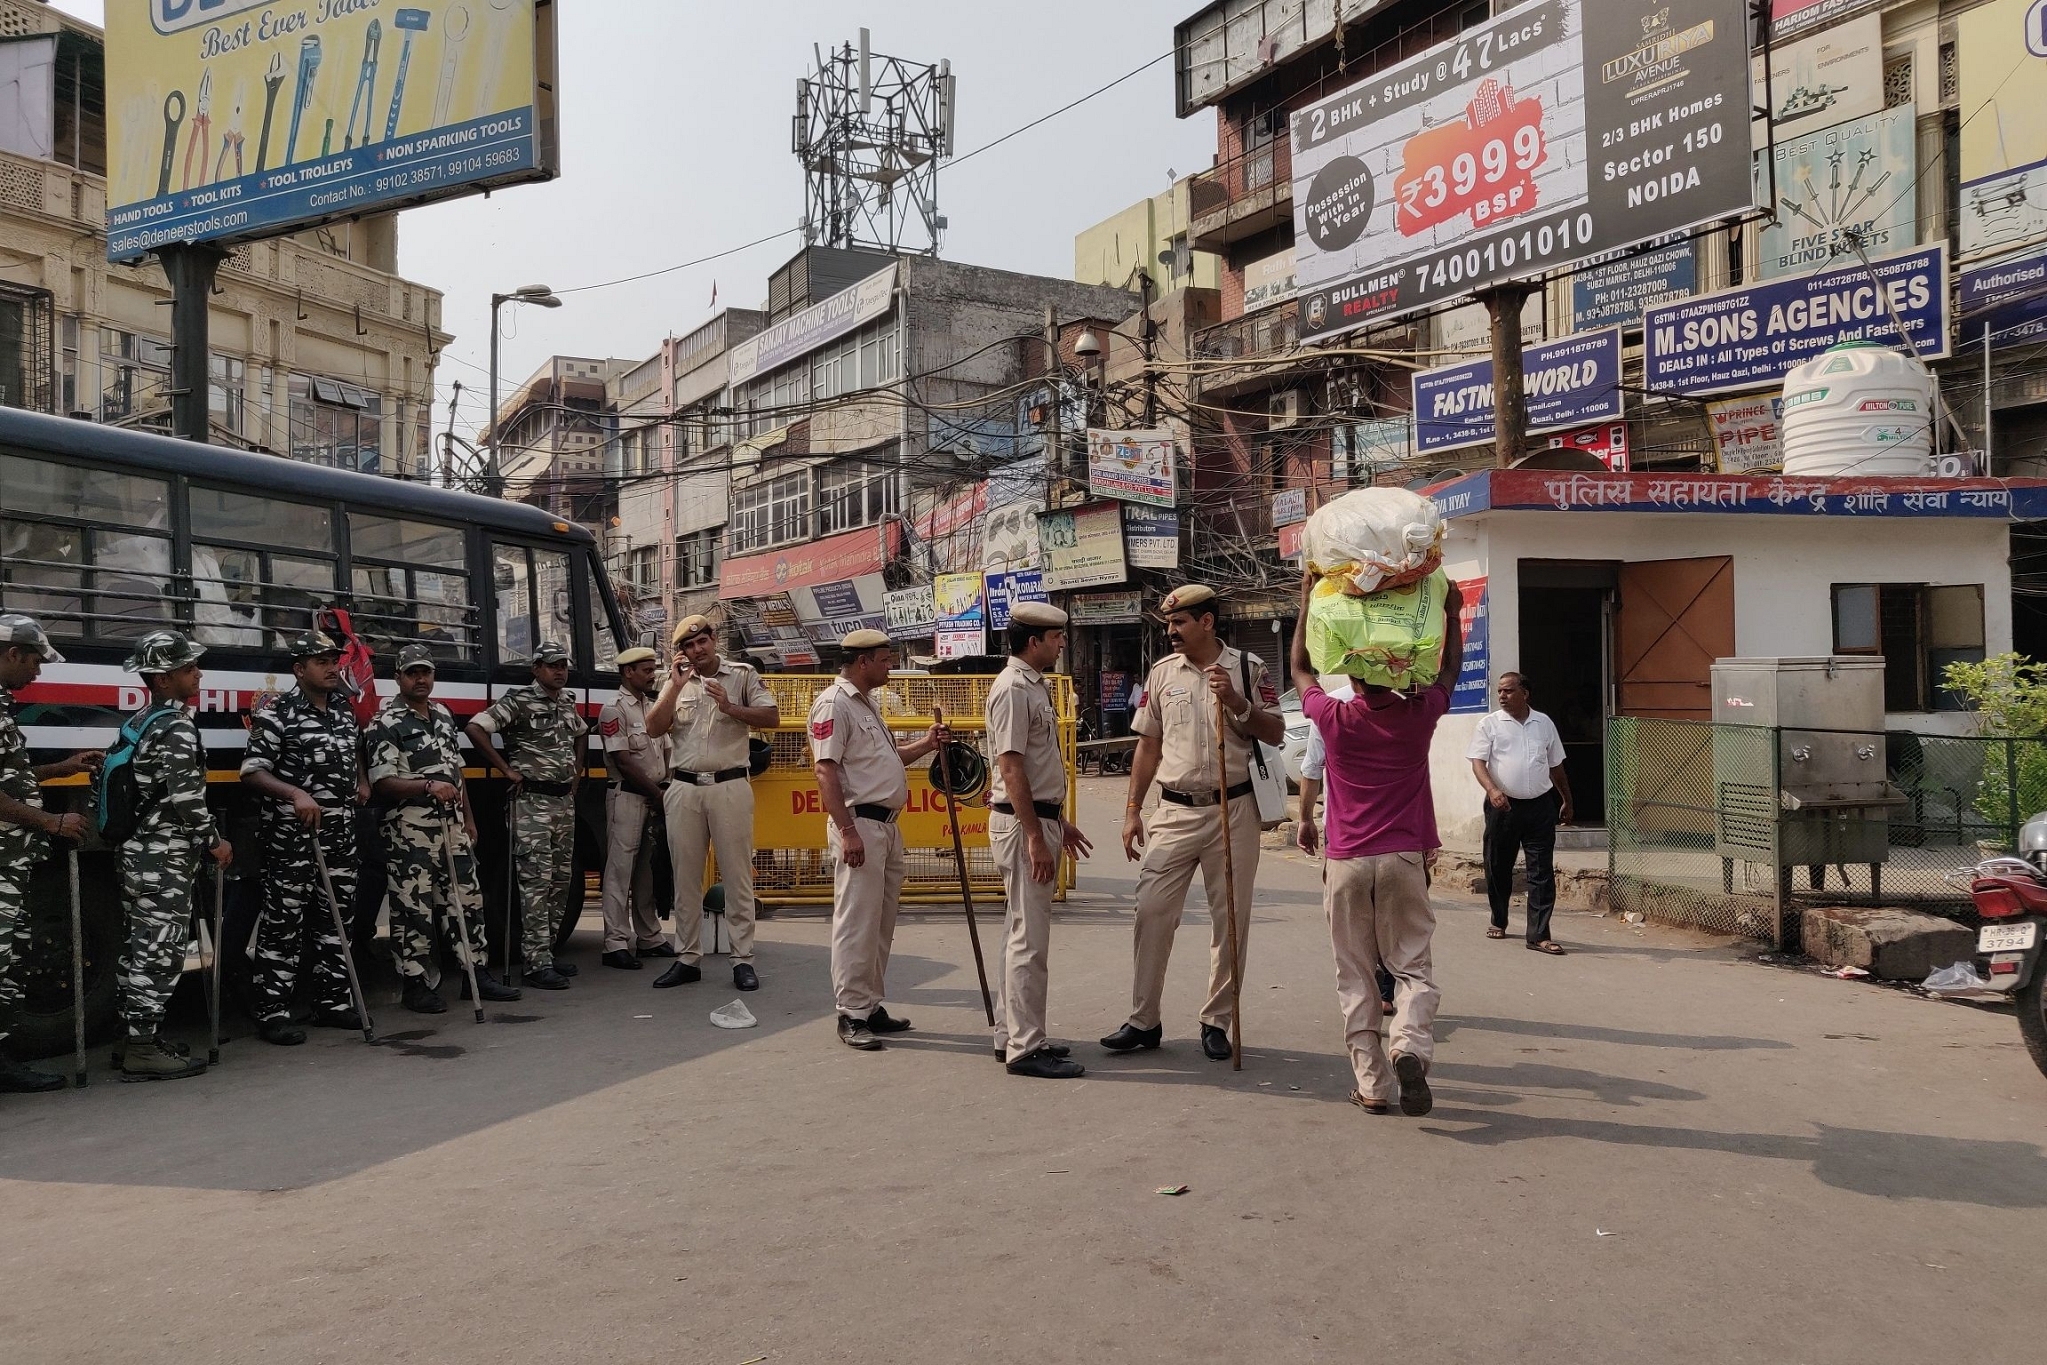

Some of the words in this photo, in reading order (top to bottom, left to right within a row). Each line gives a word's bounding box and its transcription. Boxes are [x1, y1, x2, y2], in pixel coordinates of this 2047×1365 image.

[1774, 5, 1819, 32] HARIOM
[200, 20, 251, 60] Best
[257, 9, 310, 42] Ever
[1606, 24, 1709, 81] LUXURIYA
[1634, 56, 1681, 84] AVENUE
[1310, 108, 1326, 143] 2
[1329, 99, 1363, 127] BHK
[1383, 72, 1430, 104] Study
[1435, 61, 1448, 81] @
[1452, 31, 1494, 80] 47
[1602, 127, 1624, 148] 2/3
[1629, 113, 1663, 138] BHK
[1668, 93, 1723, 123] Homes
[385, 142, 415, 161] NON
[415, 127, 478, 154] SPARKING
[479, 116, 522, 139] TOOLS
[1604, 144, 1674, 182] Sector
[1682, 122, 1722, 154] 150
[1775, 140, 1818, 162] BEST
[1825, 114, 1900, 147] QUALITY
[267, 171, 298, 189] TOOL
[298, 157, 353, 182] TROLLEYS
[309, 189, 348, 208] Contact
[376, 174, 408, 192] 99102
[410, 166, 446, 186] 38571,
[448, 156, 482, 176] 99104
[485, 147, 520, 168] 59683
[190, 191, 219, 207] TOOL
[219, 184, 242, 200] KITS
[1308, 171, 1368, 219] Possession
[1627, 166, 1701, 209] NOIDA
[113, 209, 142, 226] HAND
[143, 201, 174, 219] TOOLS
[1346, 192, 1361, 213] In
[111, 211, 249, 253] sales@deneerstools.com
[1319, 226, 1330, 240] A
[1332, 200, 1367, 230] Year
[1415, 212, 1594, 294] 7400101010
[1791, 231, 1827, 251] FIVE
[1607, 262, 1629, 277] FLOOR,
[1630, 259, 1648, 270] HAUZ
[1649, 254, 1665, 265] QAZI
[1778, 245, 1827, 269] BLIND
[1586, 279, 1605, 291] SUBZI
[1605, 271, 1633, 286] MARKET,
[1633, 261, 1677, 280] DELHI-110006
[1610, 278, 1668, 301] 011-23287009
[1807, 270, 1871, 292] 011-43728788,
[1972, 263, 2046, 293] Authorised
[1343, 288, 1399, 317] REALTY
[1655, 309, 1758, 357] M.SONS
[1766, 274, 1930, 336] AGENCIES
[758, 322, 788, 355] SANJAY
[788, 304, 826, 338] MACHINE
[827, 289, 857, 322] TOOLS
[1575, 312, 1585, 323] M.
[1654, 311, 1675, 325] GSTIN
[1540, 338, 1608, 362] PH.9911878789
[1659, 356, 1694, 374] DEALS
[1696, 353, 1709, 367] IN
[1717, 349, 1732, 364] All
[1735, 344, 1769, 363] Types
[1771, 339, 1786, 354] Of
[1788, 332, 1834, 352] Screws
[1837, 326, 1862, 343] And
[1523, 359, 1598, 399] WORLD
[1677, 376, 1689, 387] 1st
[1690, 374, 1710, 385] Floor,
[1711, 371, 1730, 382] Hauz
[1731, 367, 1750, 378] Qazi,
[1751, 362, 1772, 374] Delhi
[1555, 408, 1575, 421] Delhi
[1580, 401, 1609, 416] 110006
[1728, 404, 1766, 420] PRINCE
[1865, 401, 1888, 411] MILTON
[1899, 401, 1914, 411] PURE
[1117, 445, 1142, 461] ZEST
[1448, 492, 1471, 512] NYAY
[1544, 473, 1635, 511] पुलिस
[1648, 478, 1751, 511] सहायता
[1902, 484, 1949, 512] सेवा
[1958, 489, 2010, 511] न्याय
[1126, 524, 1156, 533] Distributors
[1158, 513, 1177, 521] PIPES
[960, 821, 987, 835] KAMLA
[1986, 937, 2025, 949] 3794
